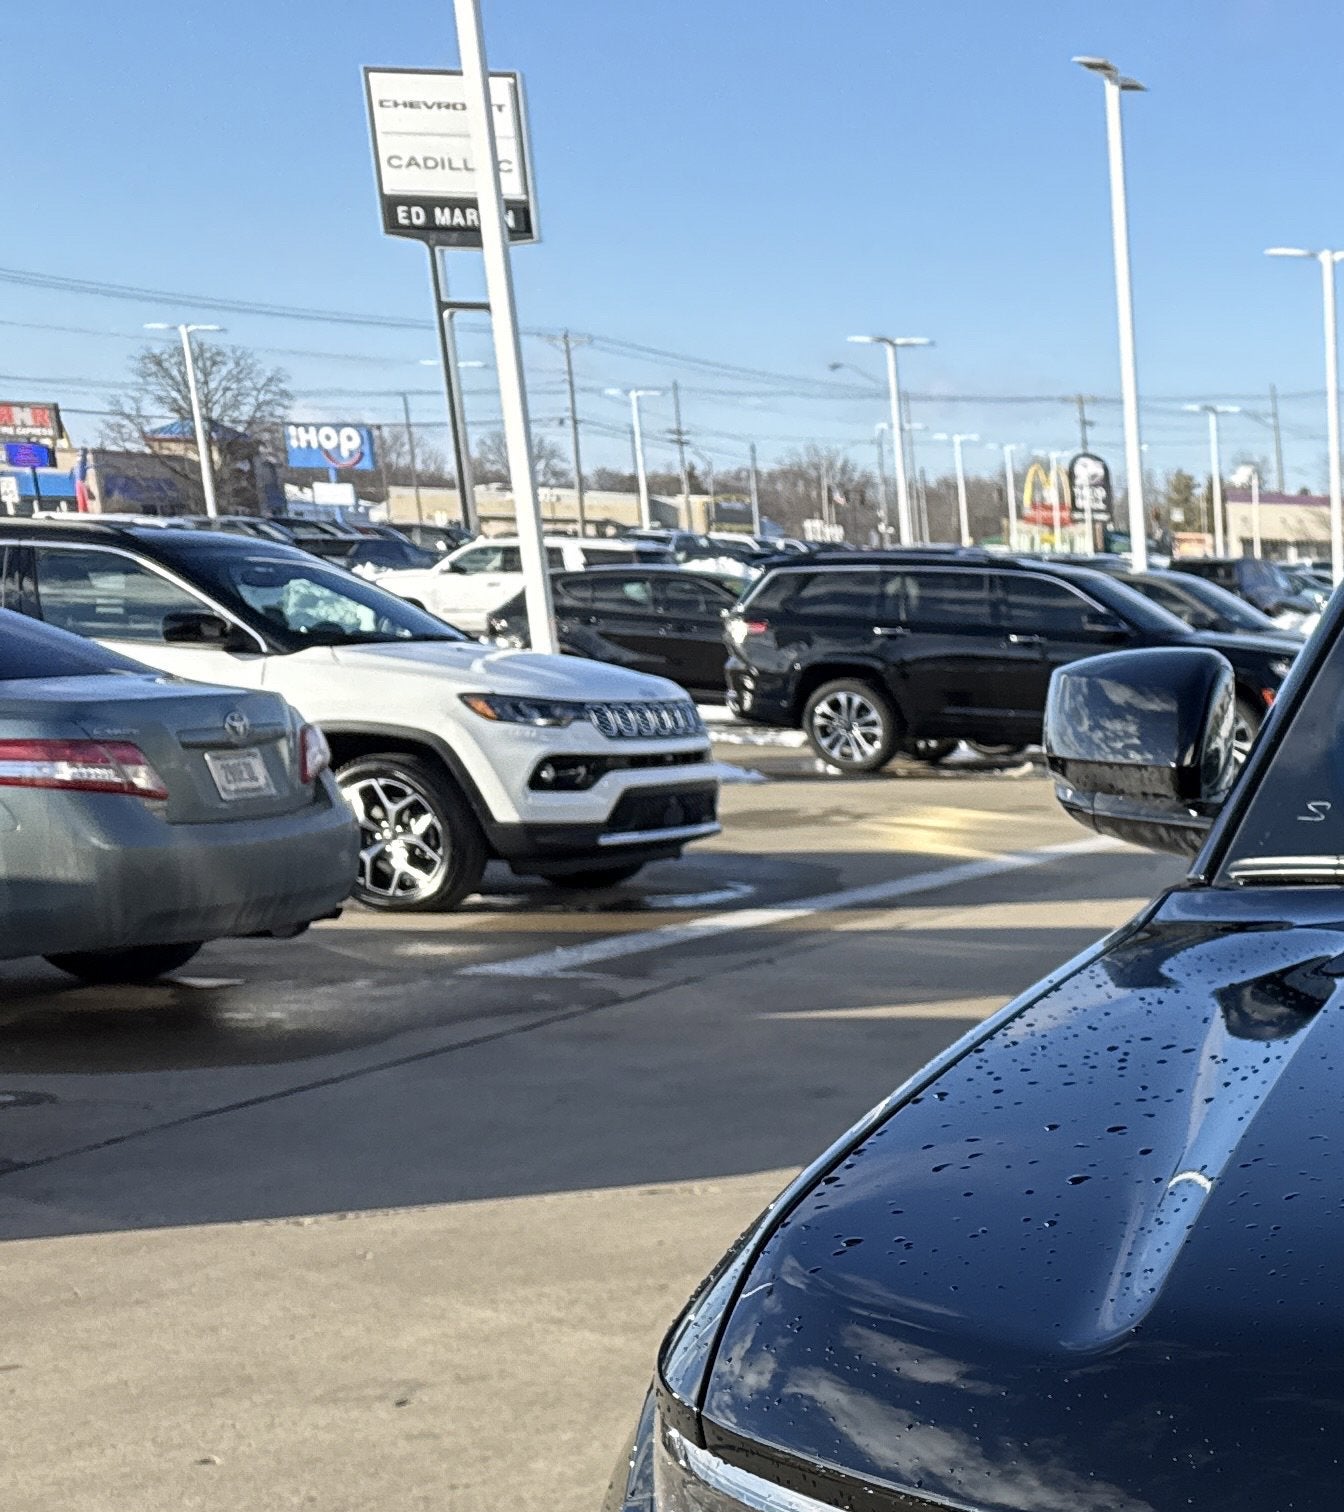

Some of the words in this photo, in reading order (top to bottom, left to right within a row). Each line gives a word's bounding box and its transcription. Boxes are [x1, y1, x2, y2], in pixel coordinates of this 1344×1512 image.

[378, 99, 506, 113] CHEVROT
[386, 154, 514, 174] CADILLC
[396, 206, 427, 226] ED
[434, 206, 516, 228] MARN
